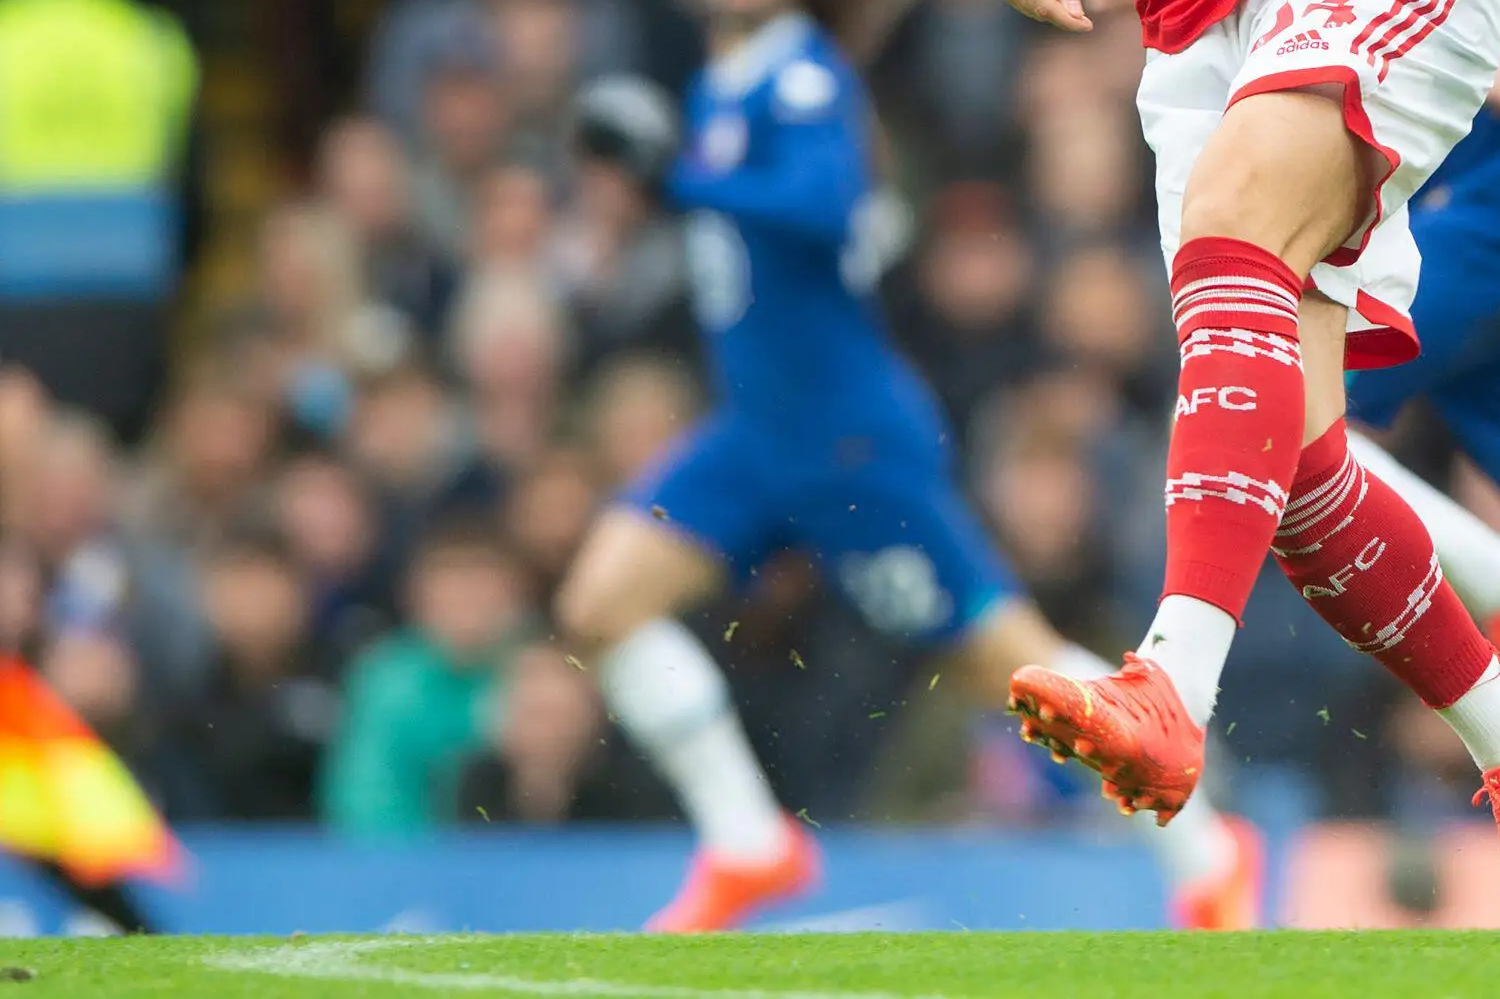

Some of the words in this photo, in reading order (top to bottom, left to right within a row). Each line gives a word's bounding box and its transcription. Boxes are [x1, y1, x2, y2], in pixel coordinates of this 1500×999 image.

[1276, 40, 1330, 56] adidas
[1174, 385, 1257, 421] AFC
[1303, 535, 1386, 599] AFC
